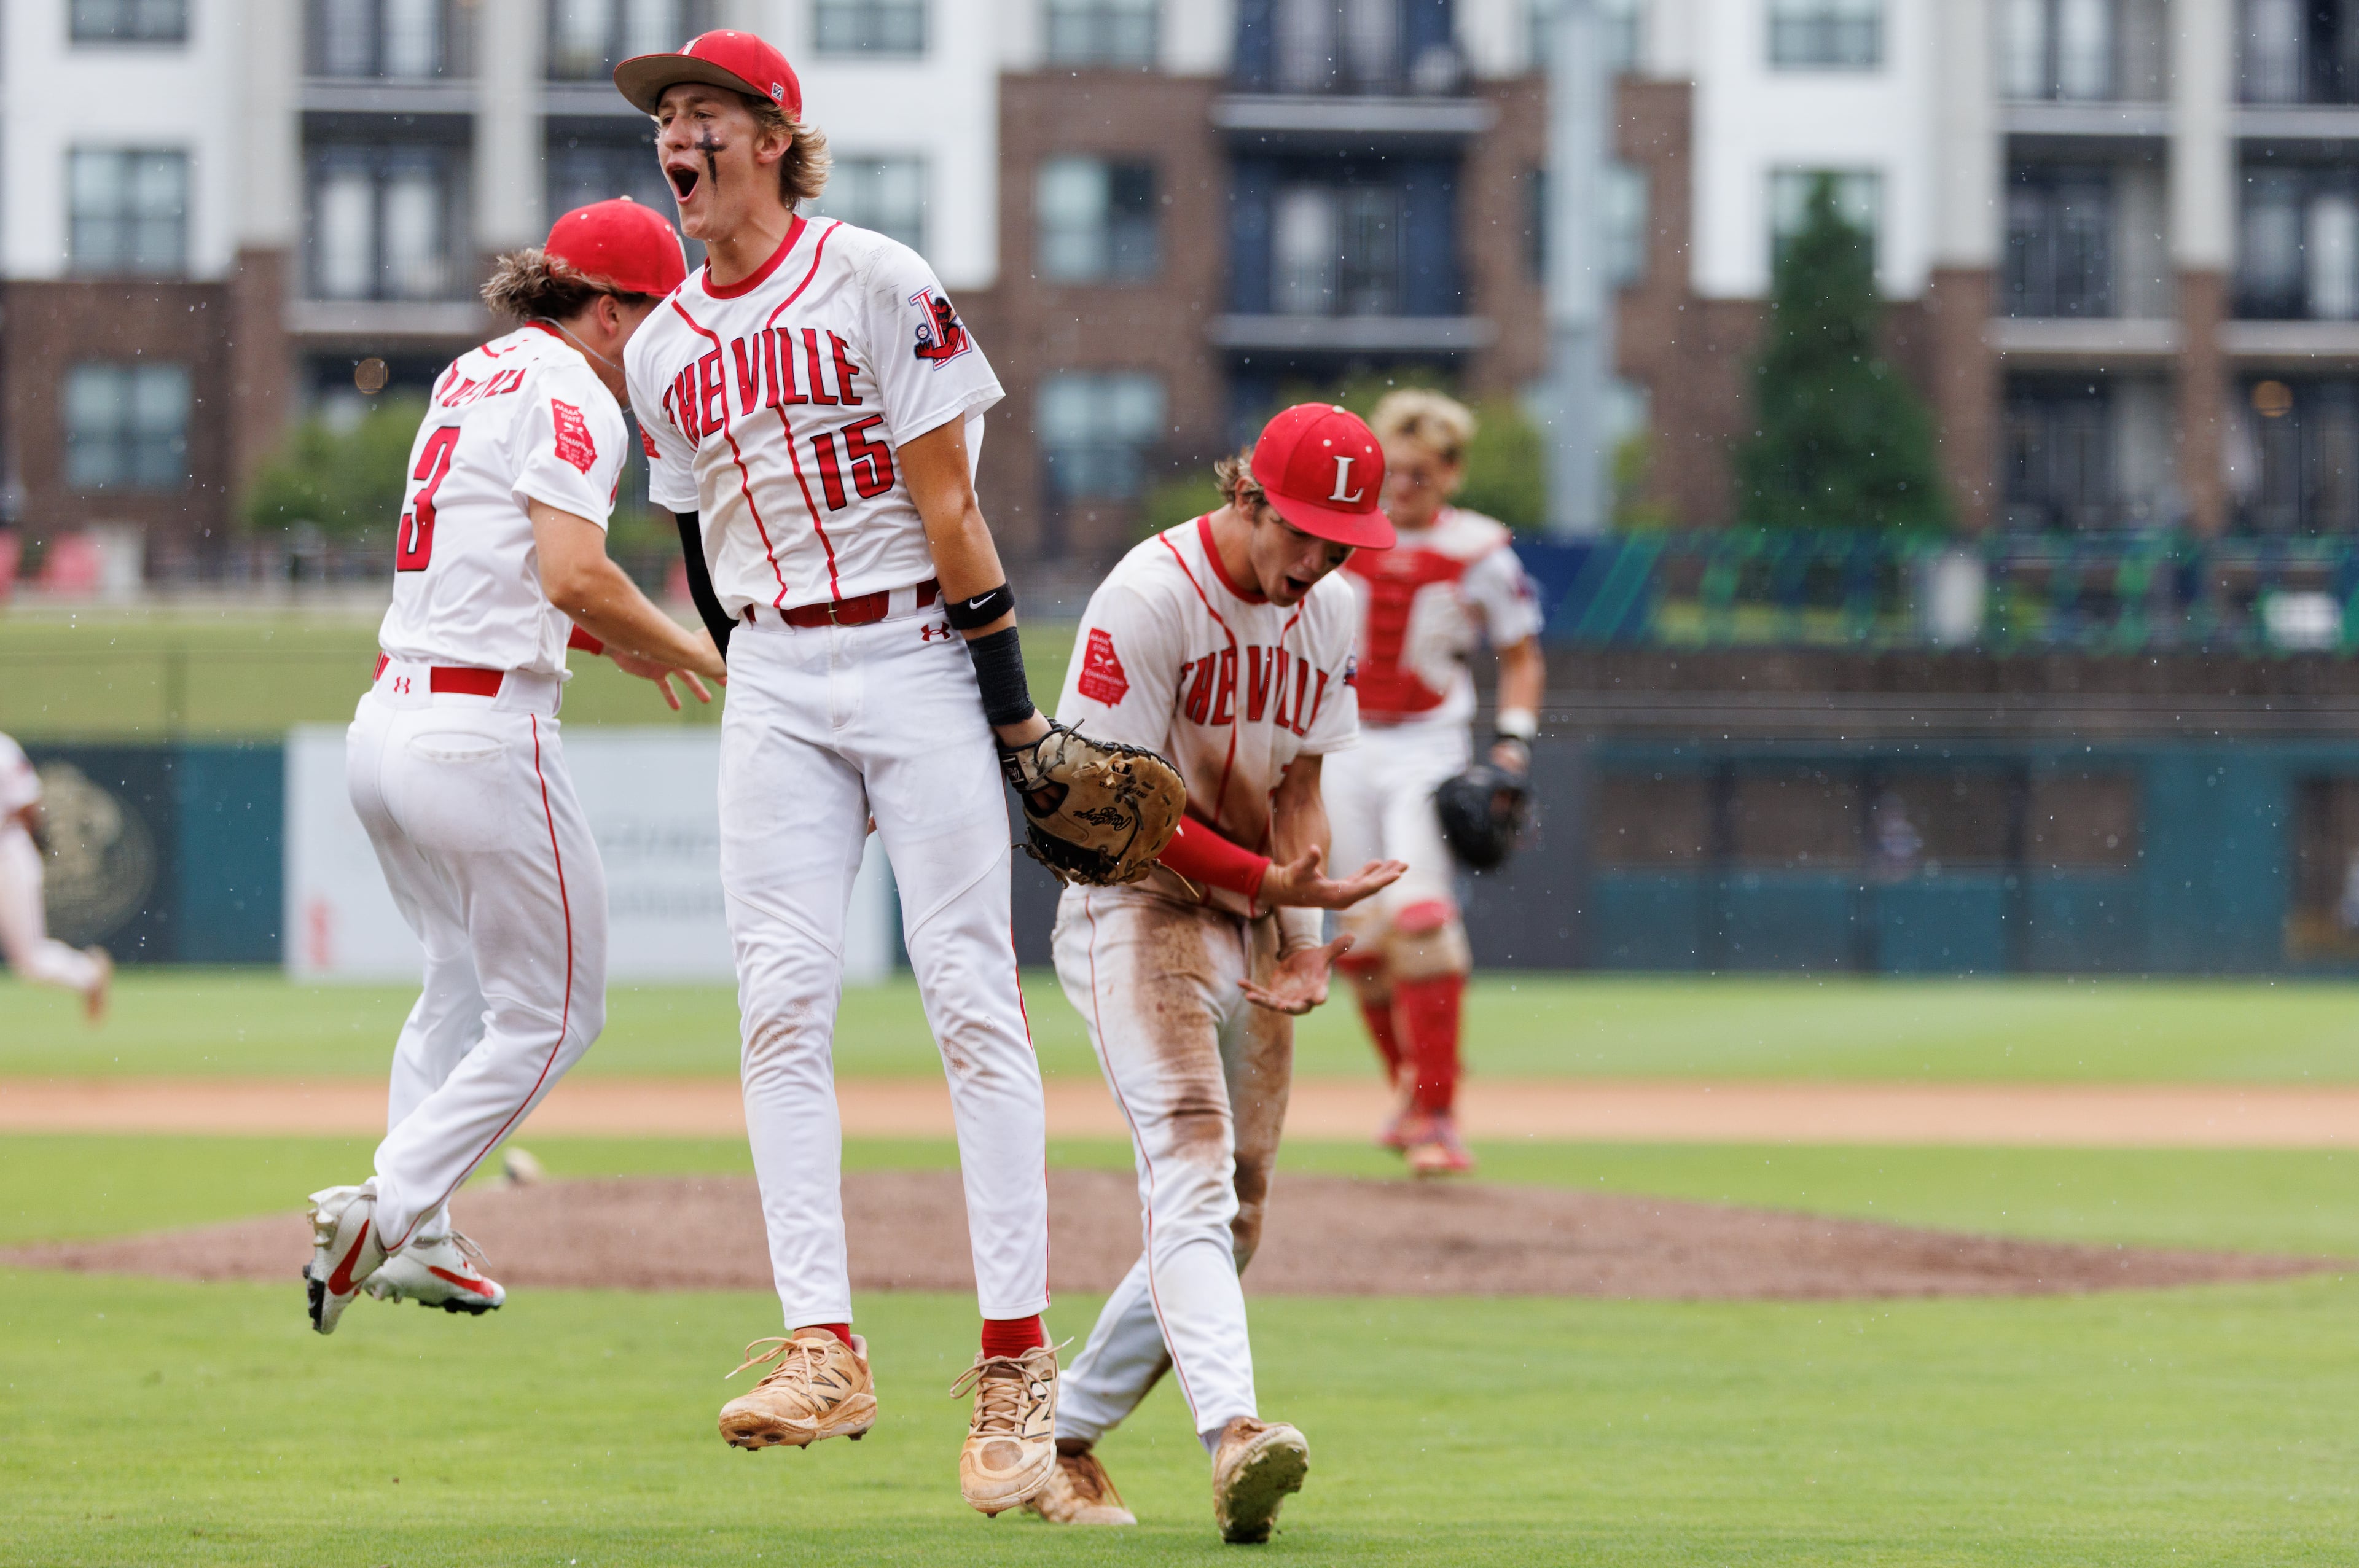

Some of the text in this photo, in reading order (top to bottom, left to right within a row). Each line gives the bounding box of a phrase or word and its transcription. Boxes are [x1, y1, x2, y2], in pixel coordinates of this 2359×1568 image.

[731, 327, 863, 416] VILLE
[561, 412, 581, 423] STATE
[810, 414, 894, 512] 15
[1328, 455, 1363, 503] L
[397, 426, 461, 572] 3
[1073, 808, 1132, 832] Rawlings
